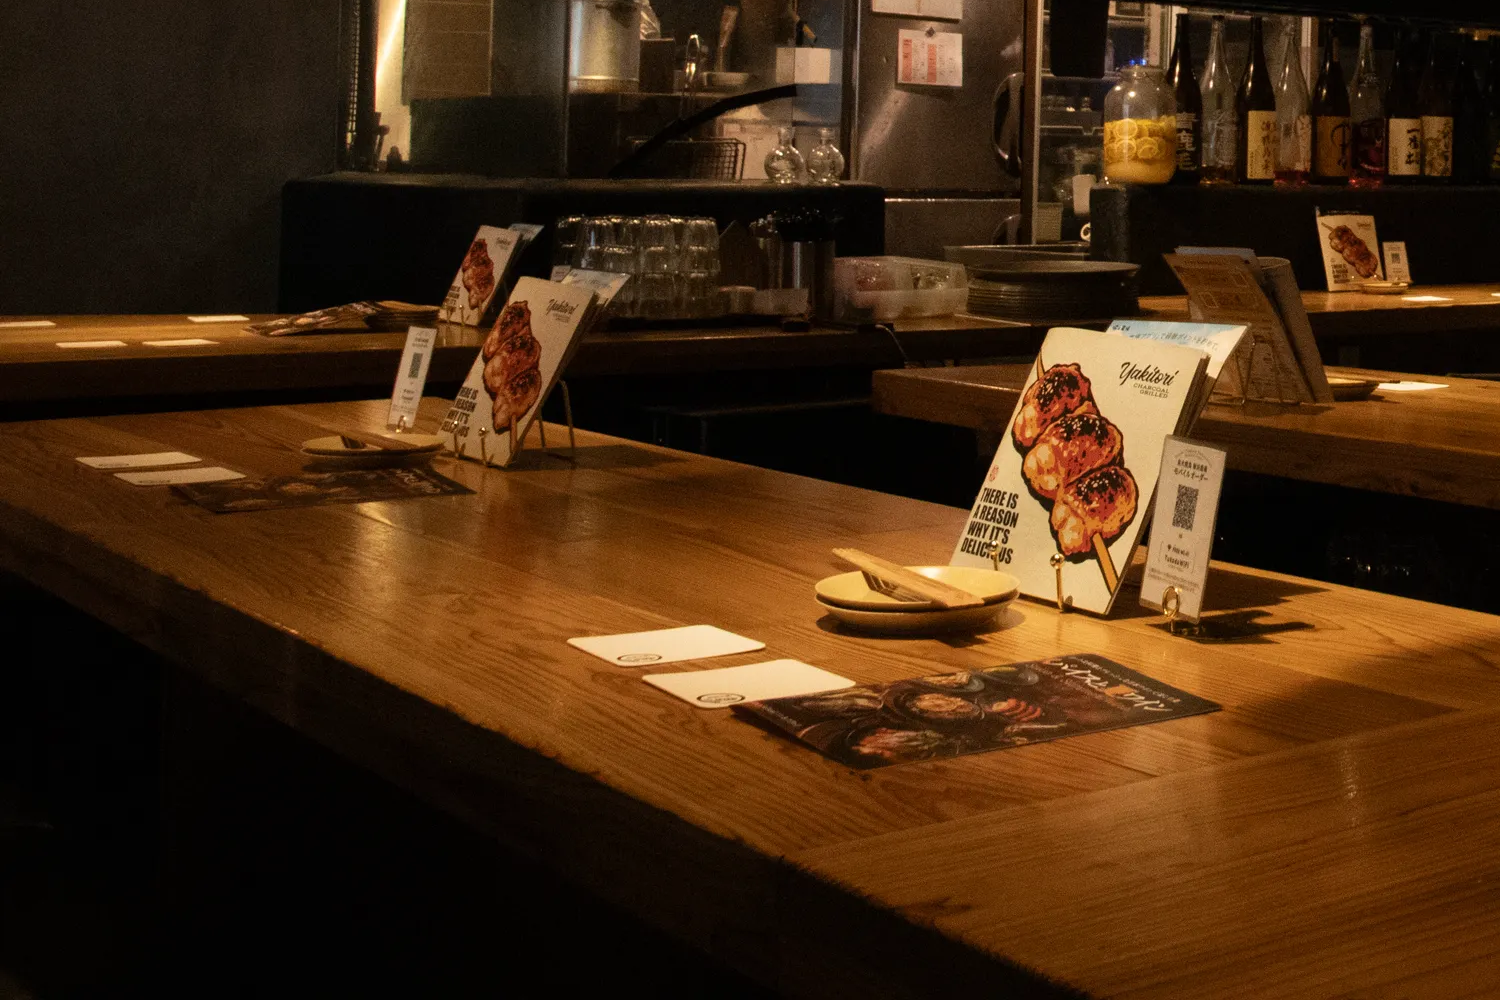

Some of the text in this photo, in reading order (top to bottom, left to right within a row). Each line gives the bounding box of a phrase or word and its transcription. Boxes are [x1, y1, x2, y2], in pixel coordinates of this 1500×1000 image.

[1119, 361, 1180, 387] Yakitori
[1132, 382, 1170, 394] CHARCOAL
[1139, 389, 1169, 399] GRILLED
[980, 487, 1019, 509] THERE IS
[973, 504, 1020, 528] A REASON
[967, 521, 1011, 545] WHY IT'S
